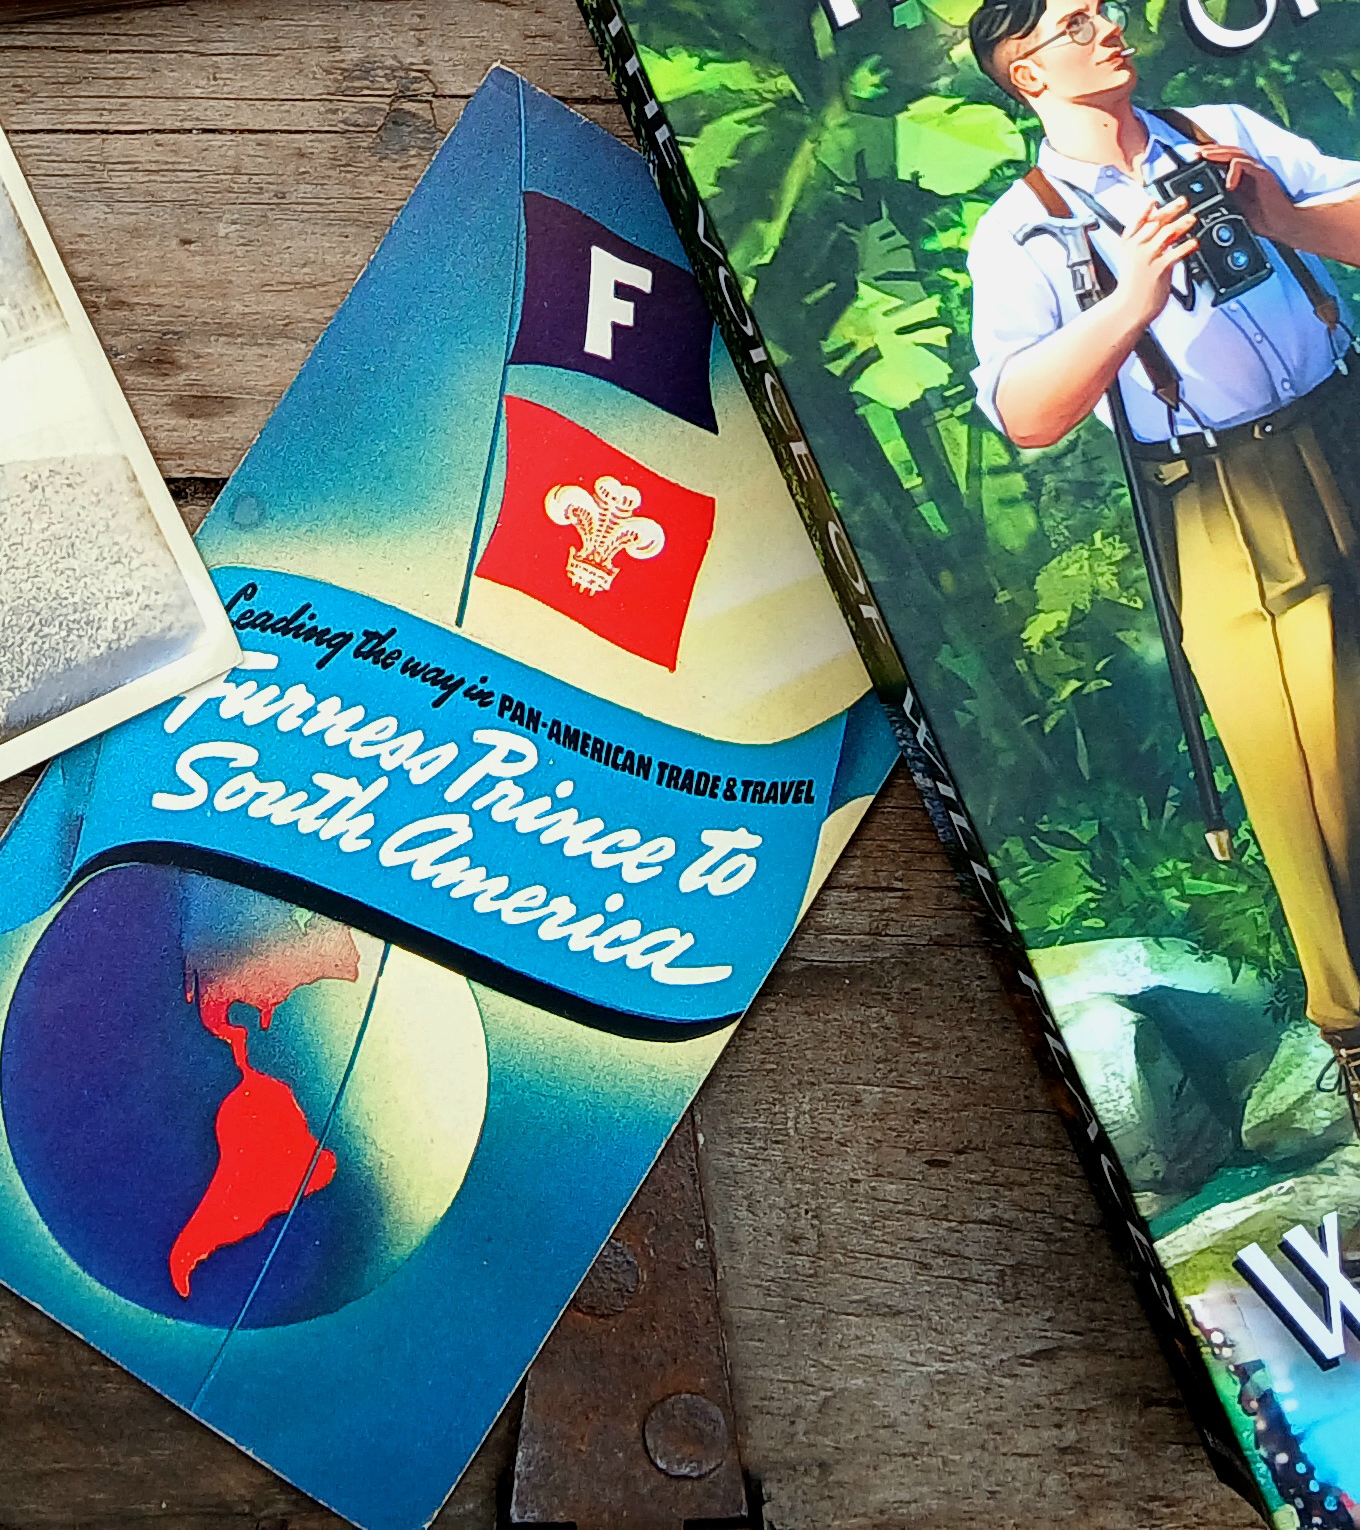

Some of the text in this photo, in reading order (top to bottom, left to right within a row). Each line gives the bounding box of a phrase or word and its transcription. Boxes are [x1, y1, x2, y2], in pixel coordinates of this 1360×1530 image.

[583, 244, 653, 361] F
[163, 652, 763, 898] Furness Prince to
[221, 581, 353, 675] Leading
[353, 630, 402, 670] the
[399, 655, 460, 710] way
[462, 671, 497, 710] in
[496, 694, 653, 782] PAN-AMERICAN
[655, 755, 722, 799] TRADE
[740, 775, 817, 806] TRAVEL
[151, 738, 733, 986] South America
